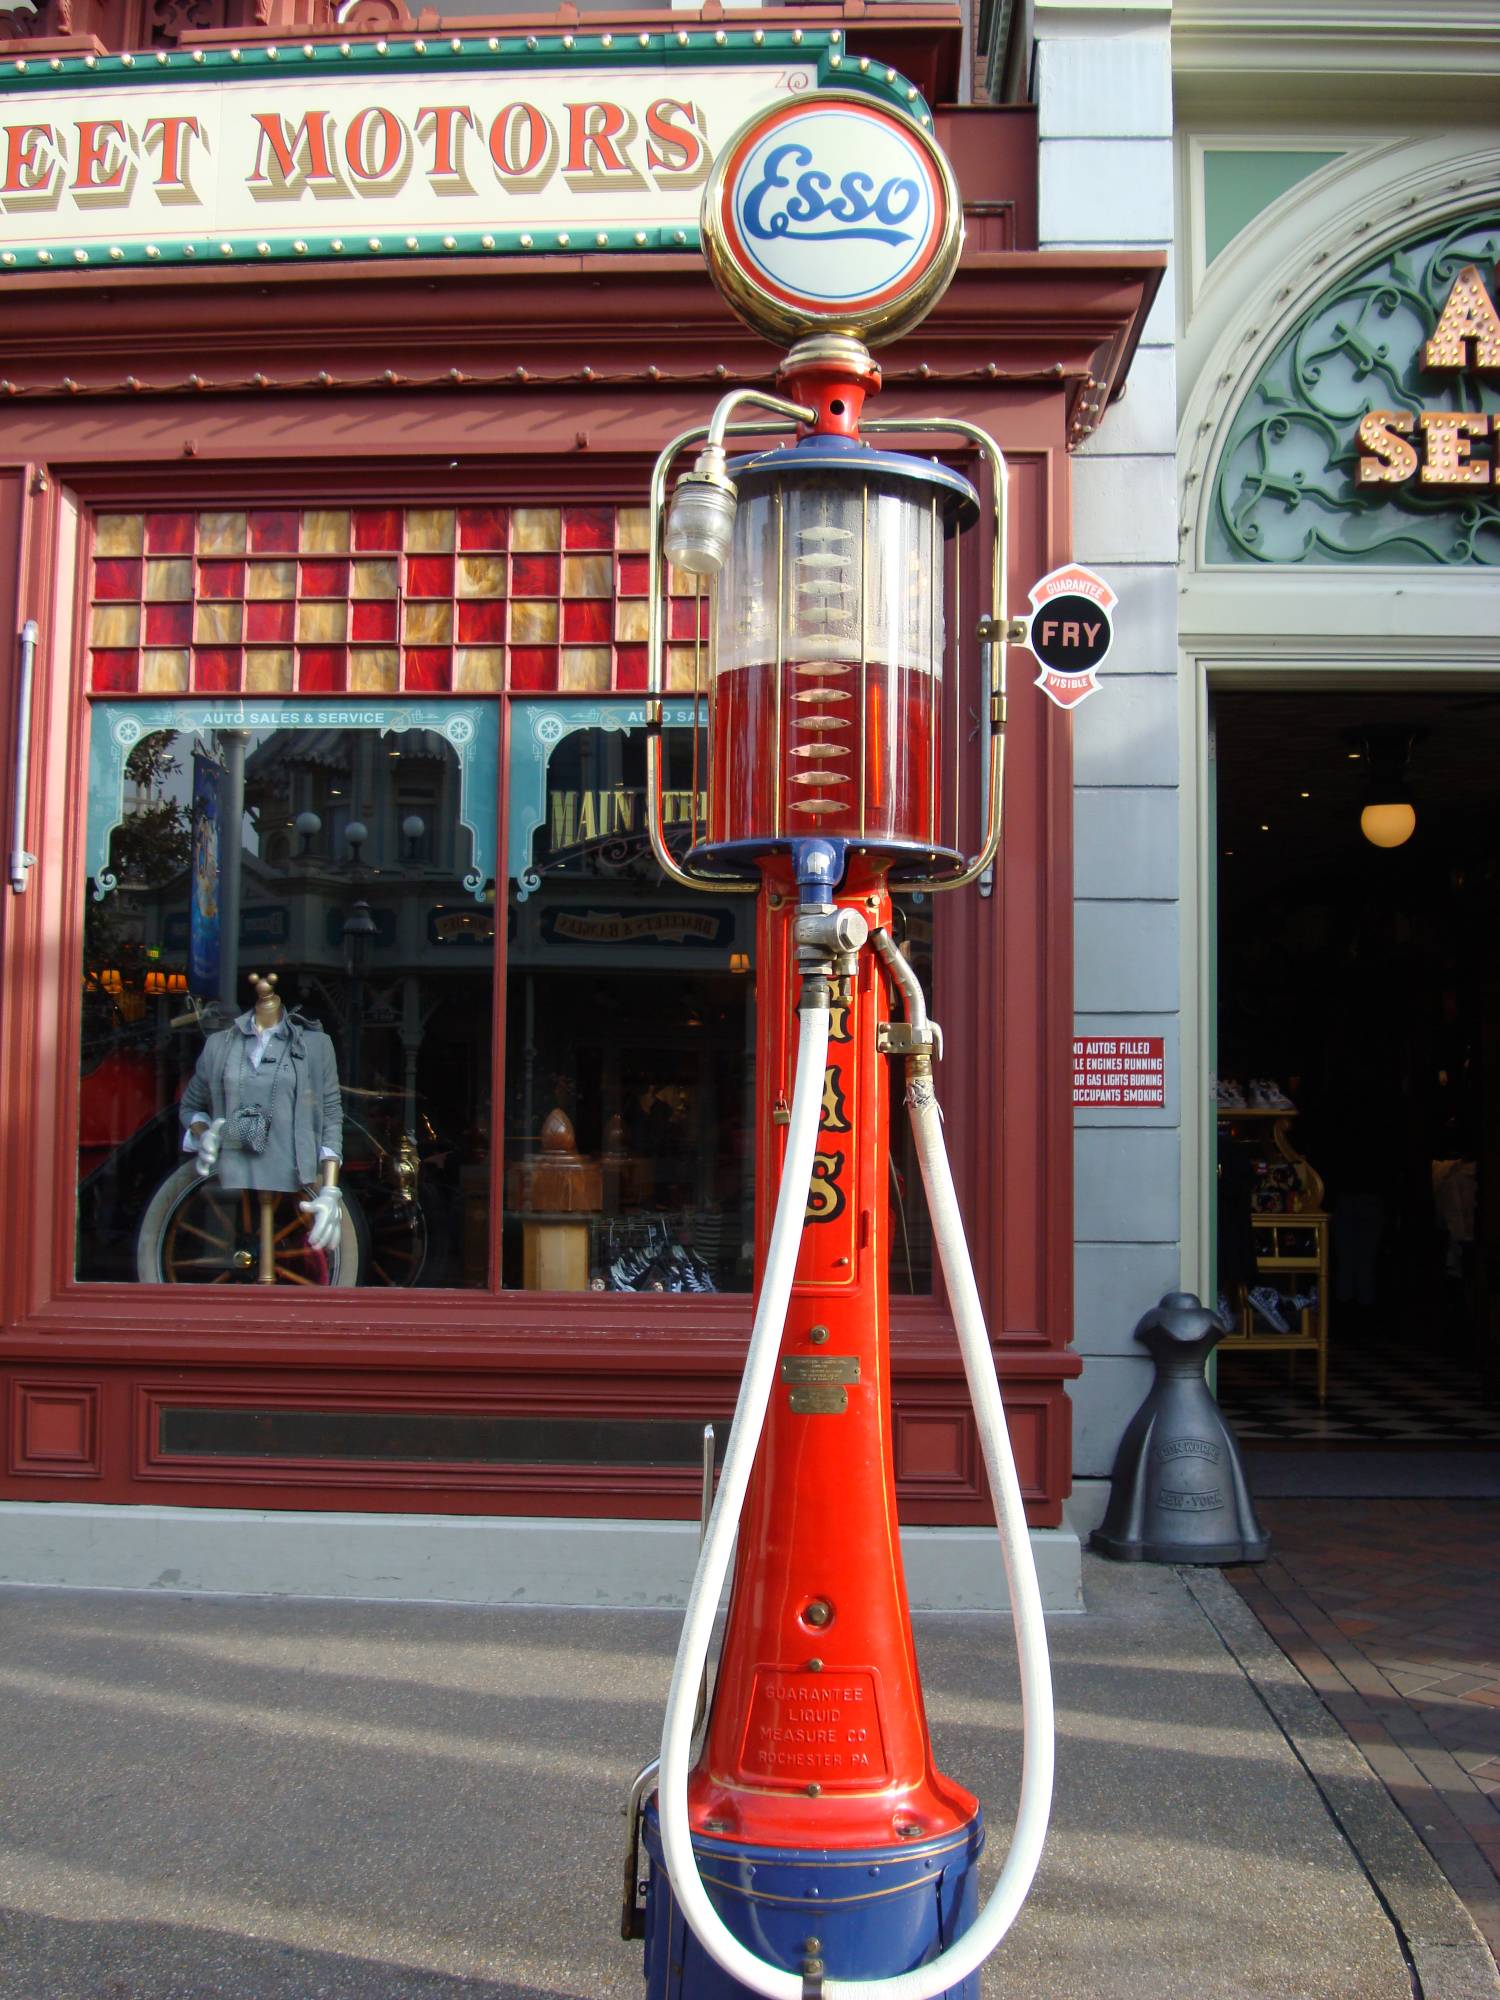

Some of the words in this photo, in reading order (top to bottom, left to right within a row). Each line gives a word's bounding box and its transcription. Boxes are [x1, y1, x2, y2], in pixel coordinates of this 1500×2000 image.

[245, 98, 702, 186] MOTORS
[743, 143, 920, 247] Esso
[1358, 410, 1500, 484] SE
[1046, 579, 1105, 599] GUARANTEE
[1042, 621, 1102, 648] FRY
[1050, 676, 1088, 689] VISIBLE
[202, 713, 244, 724] AUTO
[250, 713, 299, 724] SALES
[303, 713, 313, 724] &
[318, 712, 385, 723] SERVICE
[628, 711, 671, 722] AUO
[549, 790, 634, 853] MAIN
[1086, 1042, 1116, 1054] AUTOS
[1120, 1042, 1149, 1054] FILLED
[1086, 1058, 1122, 1070] ENGINES
[1124, 1058, 1162, 1070] RUNNING
[1074, 1074, 1085, 1086] OR
[1087, 1074, 1101, 1086] GAS
[1103, 1074, 1128, 1086] LIGHTS
[1130, 1074, 1162, 1086] BURNING
[1073, 1089, 1120, 1101] OCCUPANTS
[1124, 1089, 1162, 1101] SMOKING
[766, 1686, 863, 1702] GUARANTEE
[789, 1708, 841, 1723] LIQUID
[760, 1727, 836, 1743] MEASURE
[758, 1751, 842, 1766] ROCHESTER
[851, 1752, 869, 1766] PA
